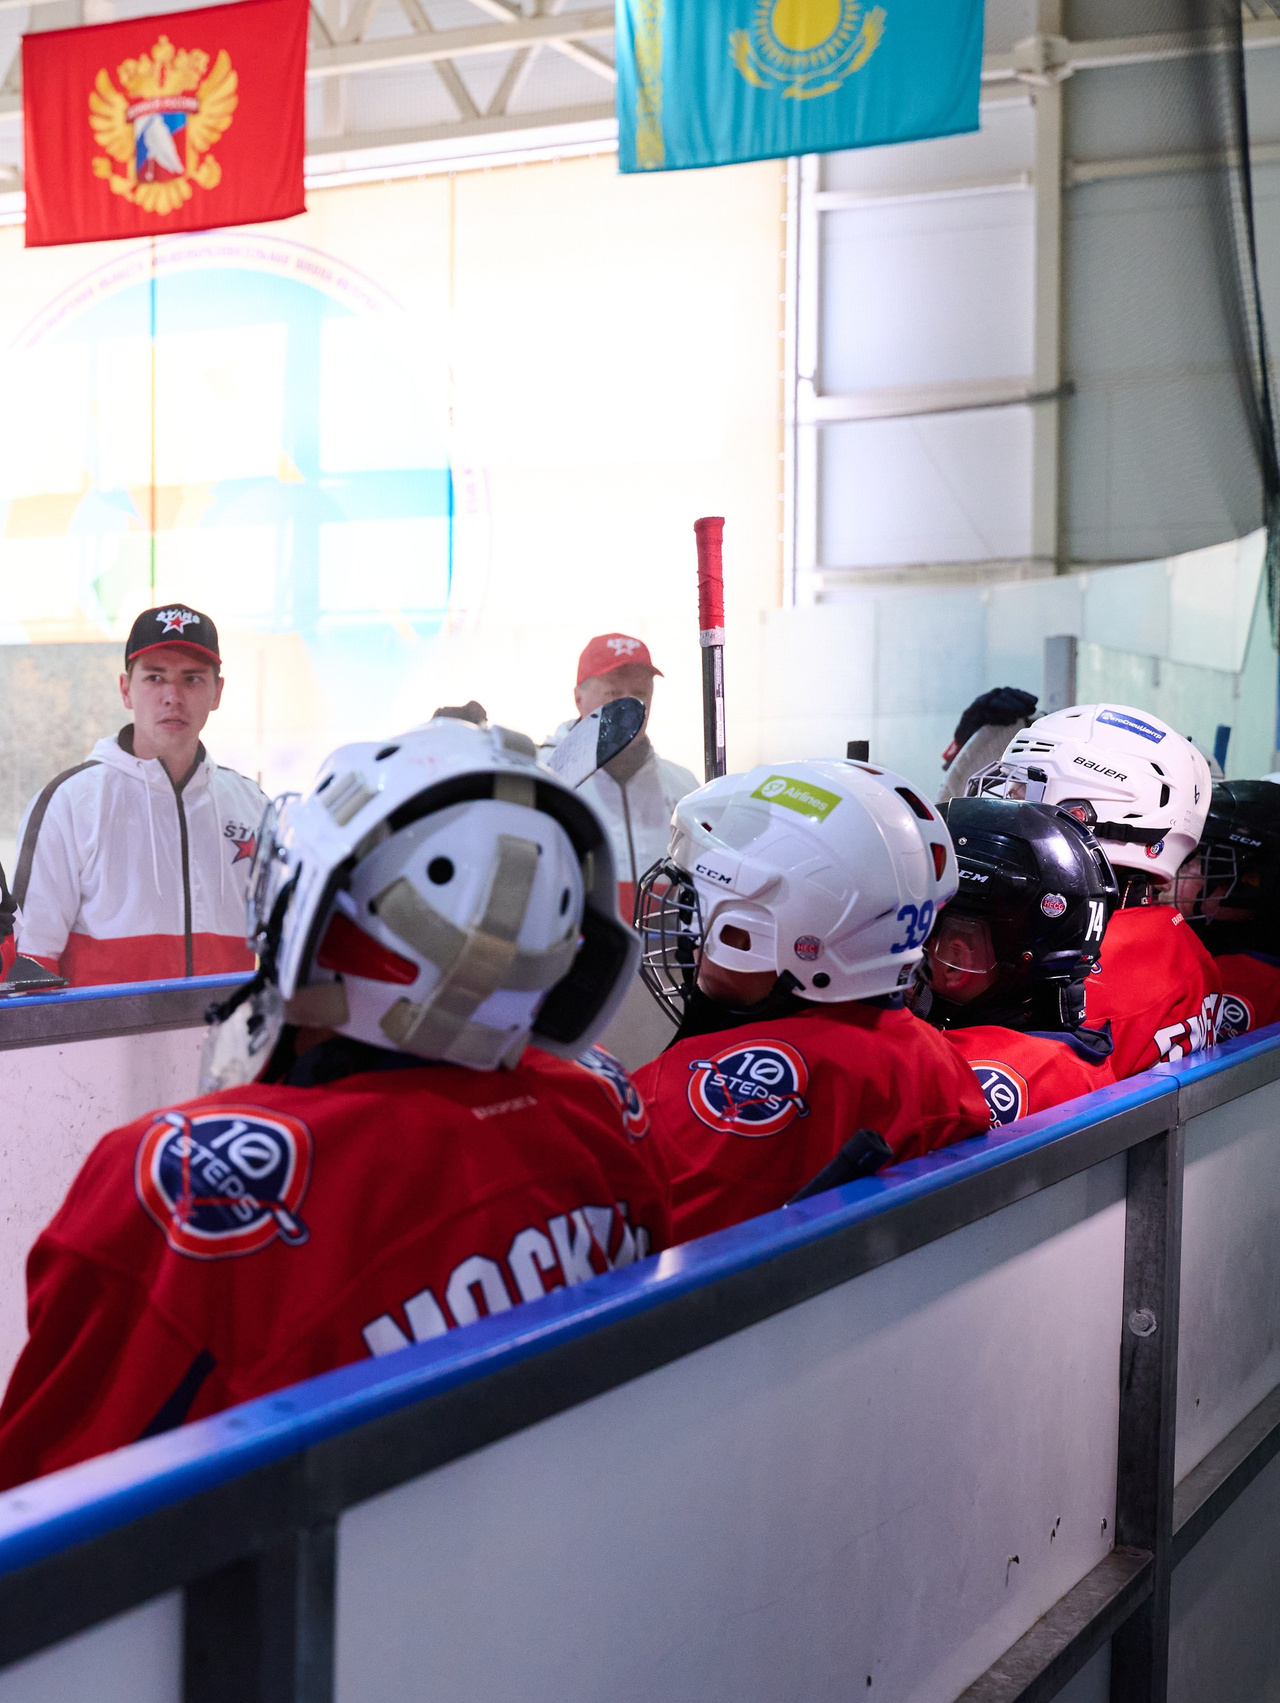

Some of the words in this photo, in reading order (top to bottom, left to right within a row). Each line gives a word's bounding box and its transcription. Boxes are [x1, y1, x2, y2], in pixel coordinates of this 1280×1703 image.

[783, 786, 829, 812] Airlines
[1228, 833, 1262, 847] CCM
[695, 864, 733, 885] CCM
[957, 869, 990, 884] CM
[890, 899, 934, 954] 39
[736, 1052, 785, 1086] 10
[709, 1073, 783, 1111] STEPS
[981, 1071, 1015, 1112] 10
[210, 1120, 282, 1181] 10
[168, 1135, 261, 1223] STEPS
